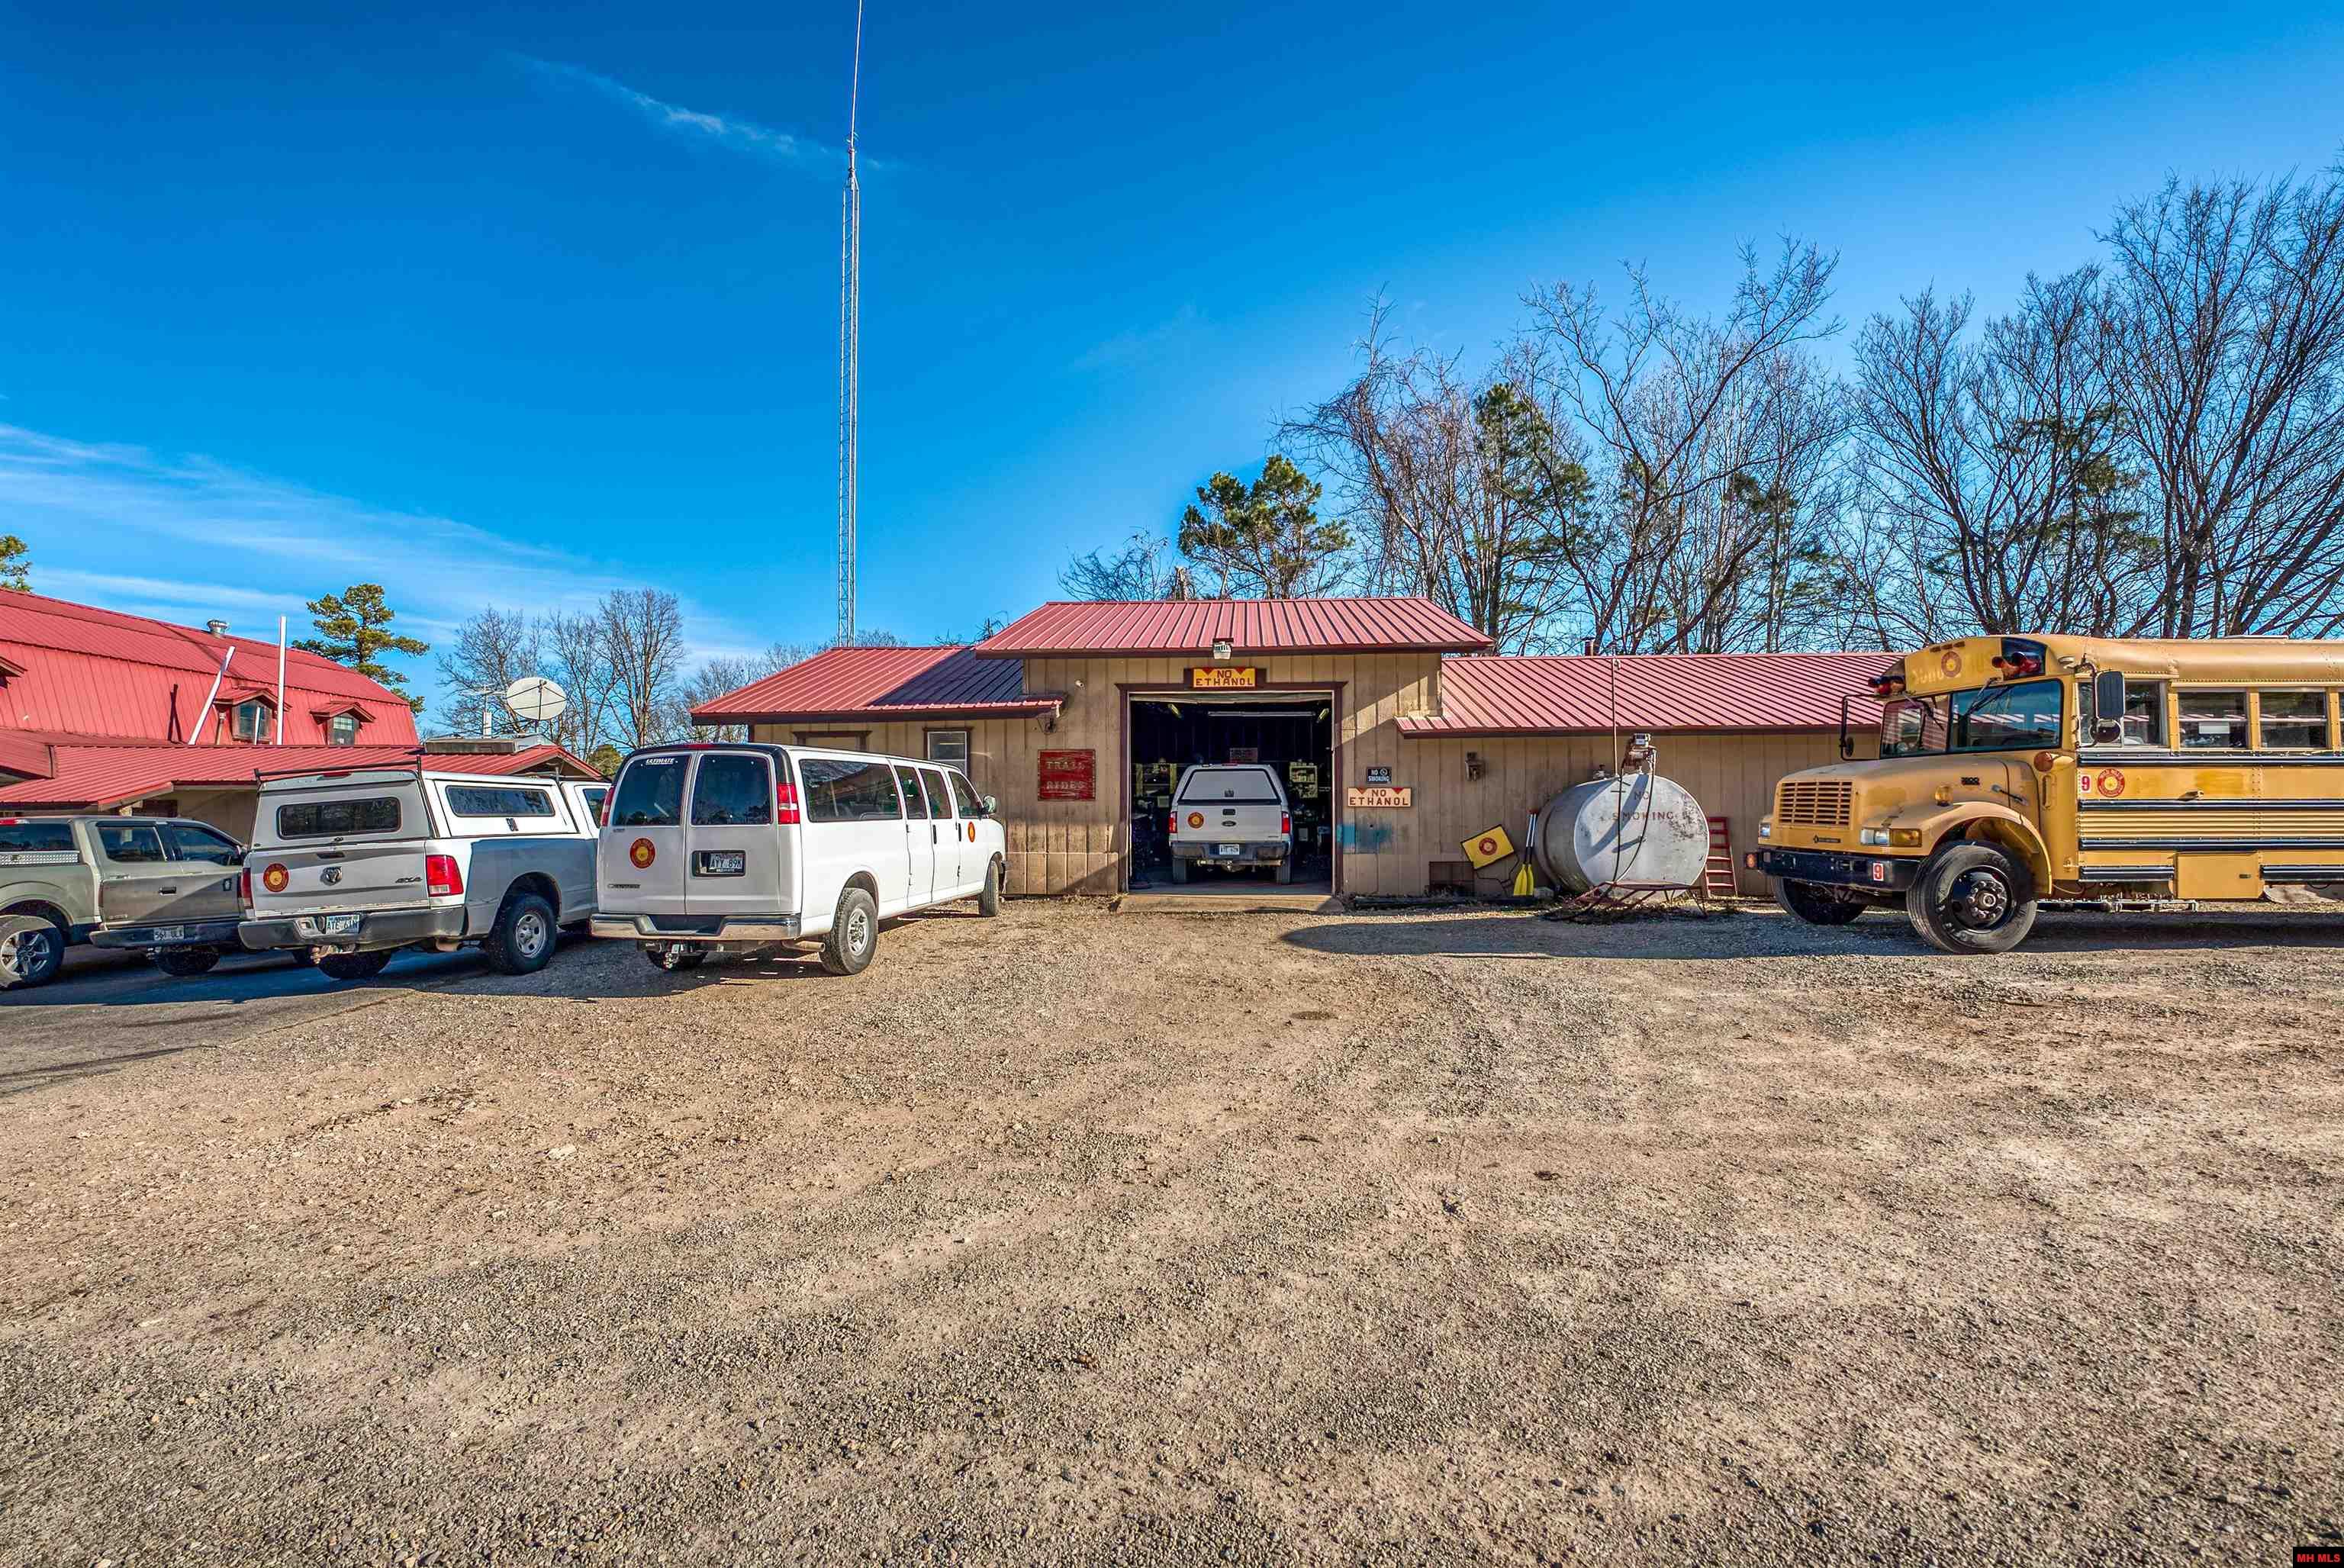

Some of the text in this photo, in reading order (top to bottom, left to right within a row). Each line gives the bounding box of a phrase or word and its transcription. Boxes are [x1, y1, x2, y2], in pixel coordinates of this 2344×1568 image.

[1196, 678, 1253, 686] ETHANOL
[2081, 775, 2091, 791] 9
[1349, 797, 1409, 806] ETHANOL
[1874, 864, 1883, 880] 9
